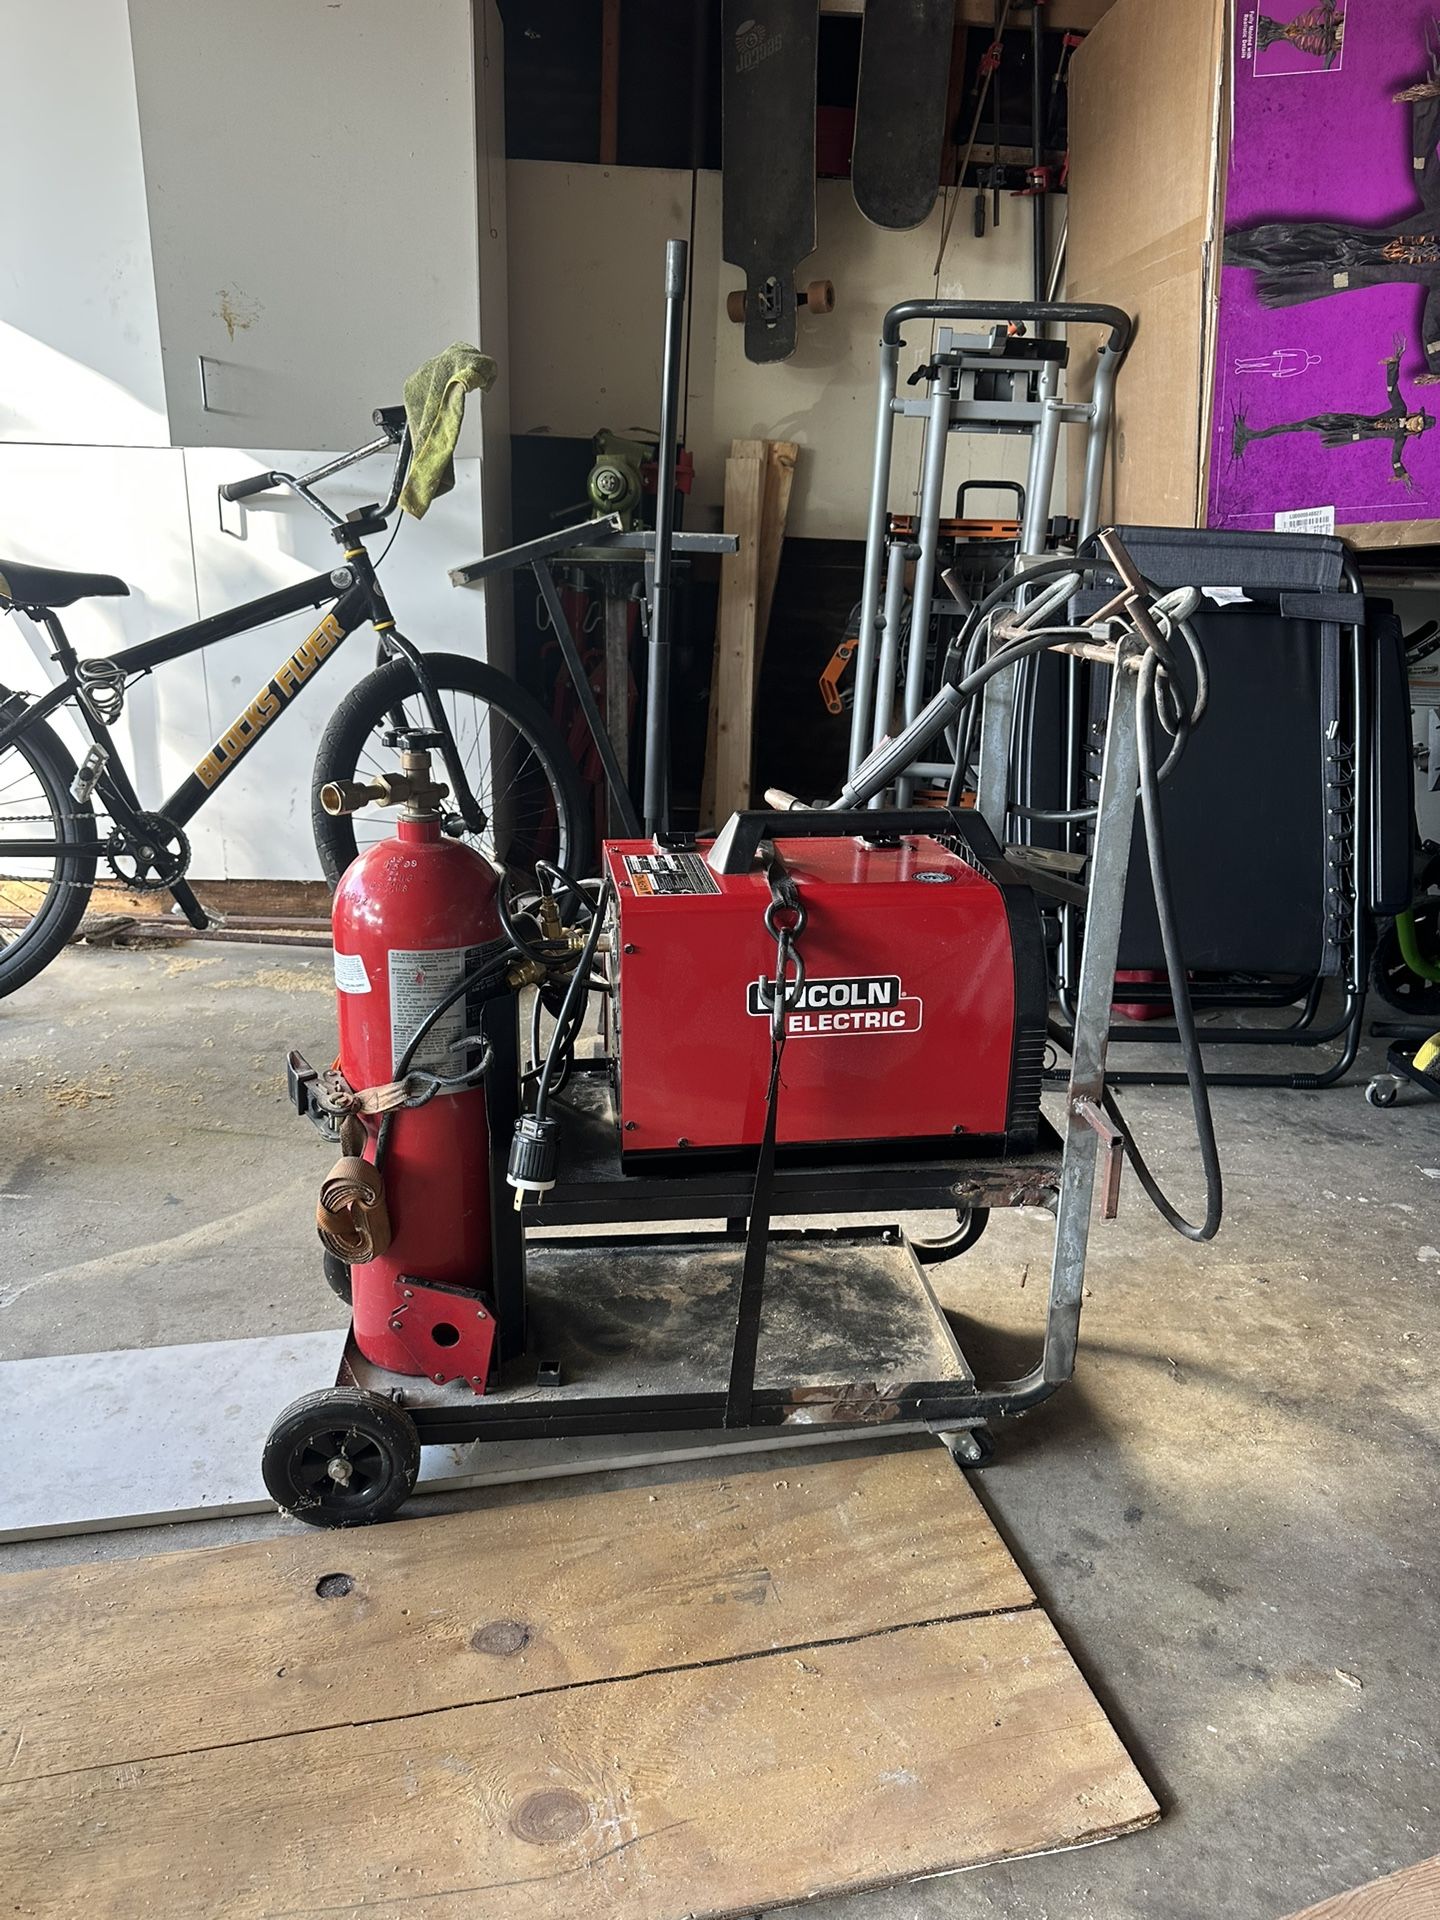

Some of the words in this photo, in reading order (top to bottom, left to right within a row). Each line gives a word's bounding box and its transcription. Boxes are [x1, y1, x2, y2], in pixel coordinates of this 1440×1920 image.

[195, 687, 281, 790] BLOCKS
[274, 613, 346, 698] FLYER
[789, 1011, 906, 1032] ELECTRIC
